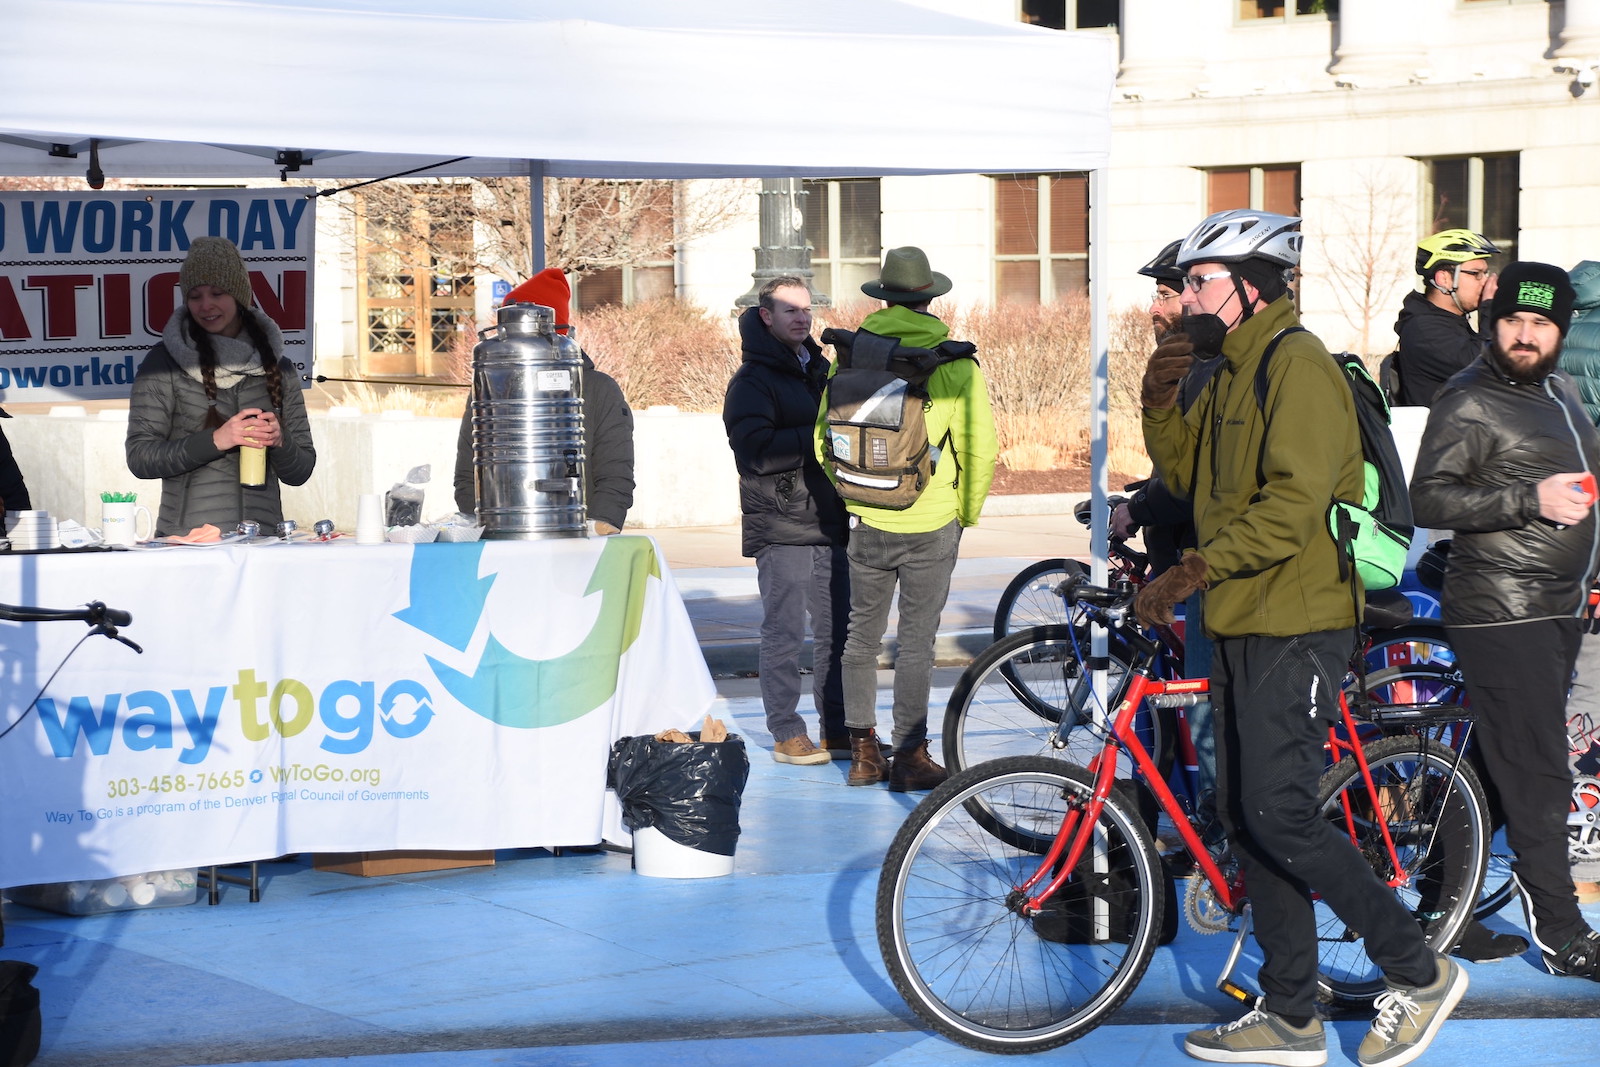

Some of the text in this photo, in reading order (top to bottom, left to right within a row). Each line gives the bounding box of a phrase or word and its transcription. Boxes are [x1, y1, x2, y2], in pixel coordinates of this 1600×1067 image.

[21, 199, 195, 254] WORK
[208, 198, 307, 251] DAY
[1519, 287, 1554, 300] FOOD
[0, 355, 140, 389] oworkd
[107, 769, 245, 798] 303-458-7665
[45, 811, 73, 824] Way
[78, 810, 93, 821] To
[97, 808, 113, 819] Go
[116, 806, 123, 816] is
[127, 807, 133, 815] a
[137, 803, 186, 816] program
[189, 799, 201, 811] of
[204, 799, 220, 809] the
[225, 795, 267, 808] Denver
[300, 789, 344, 801] Council
[347, 790, 358, 801] of
[361, 790, 429, 801] Governments
